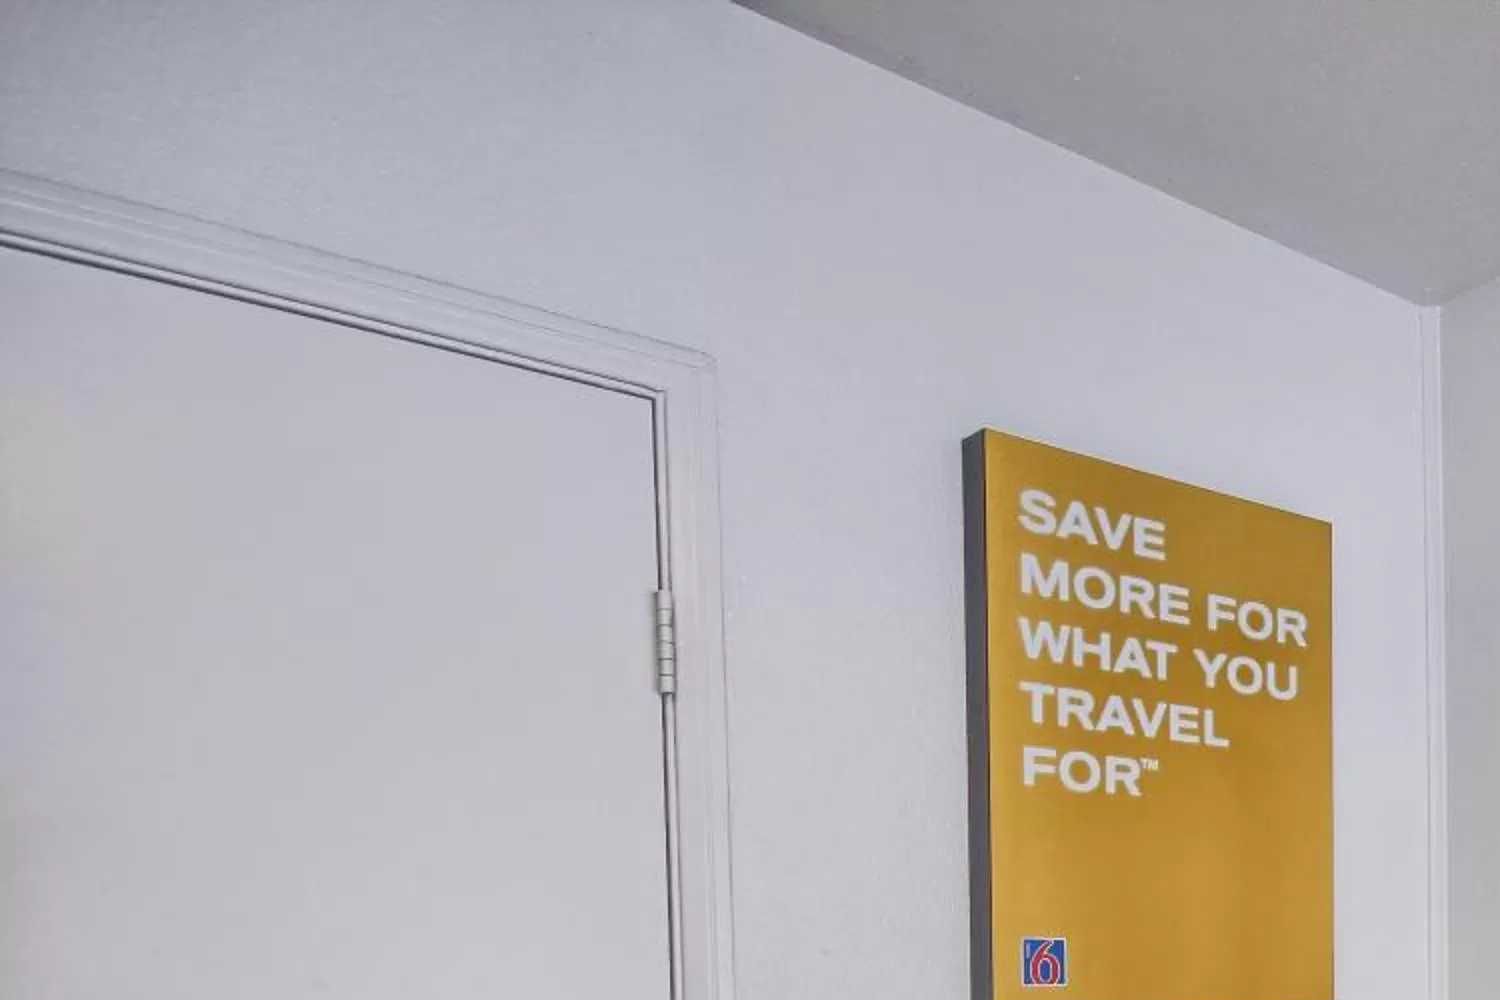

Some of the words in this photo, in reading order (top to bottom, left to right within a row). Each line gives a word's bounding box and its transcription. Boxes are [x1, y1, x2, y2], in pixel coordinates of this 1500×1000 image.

[1017, 488, 1167, 561] SAVE
[1018, 551, 1191, 626] MORE
[1206, 592, 1309, 648] FOR
[1016, 615, 1179, 681] WHAT
[1194, 648, 1300, 701] YOU
[1017, 679, 1231, 748] TRAVEL
[1030, 939, 1061, 986] 6
